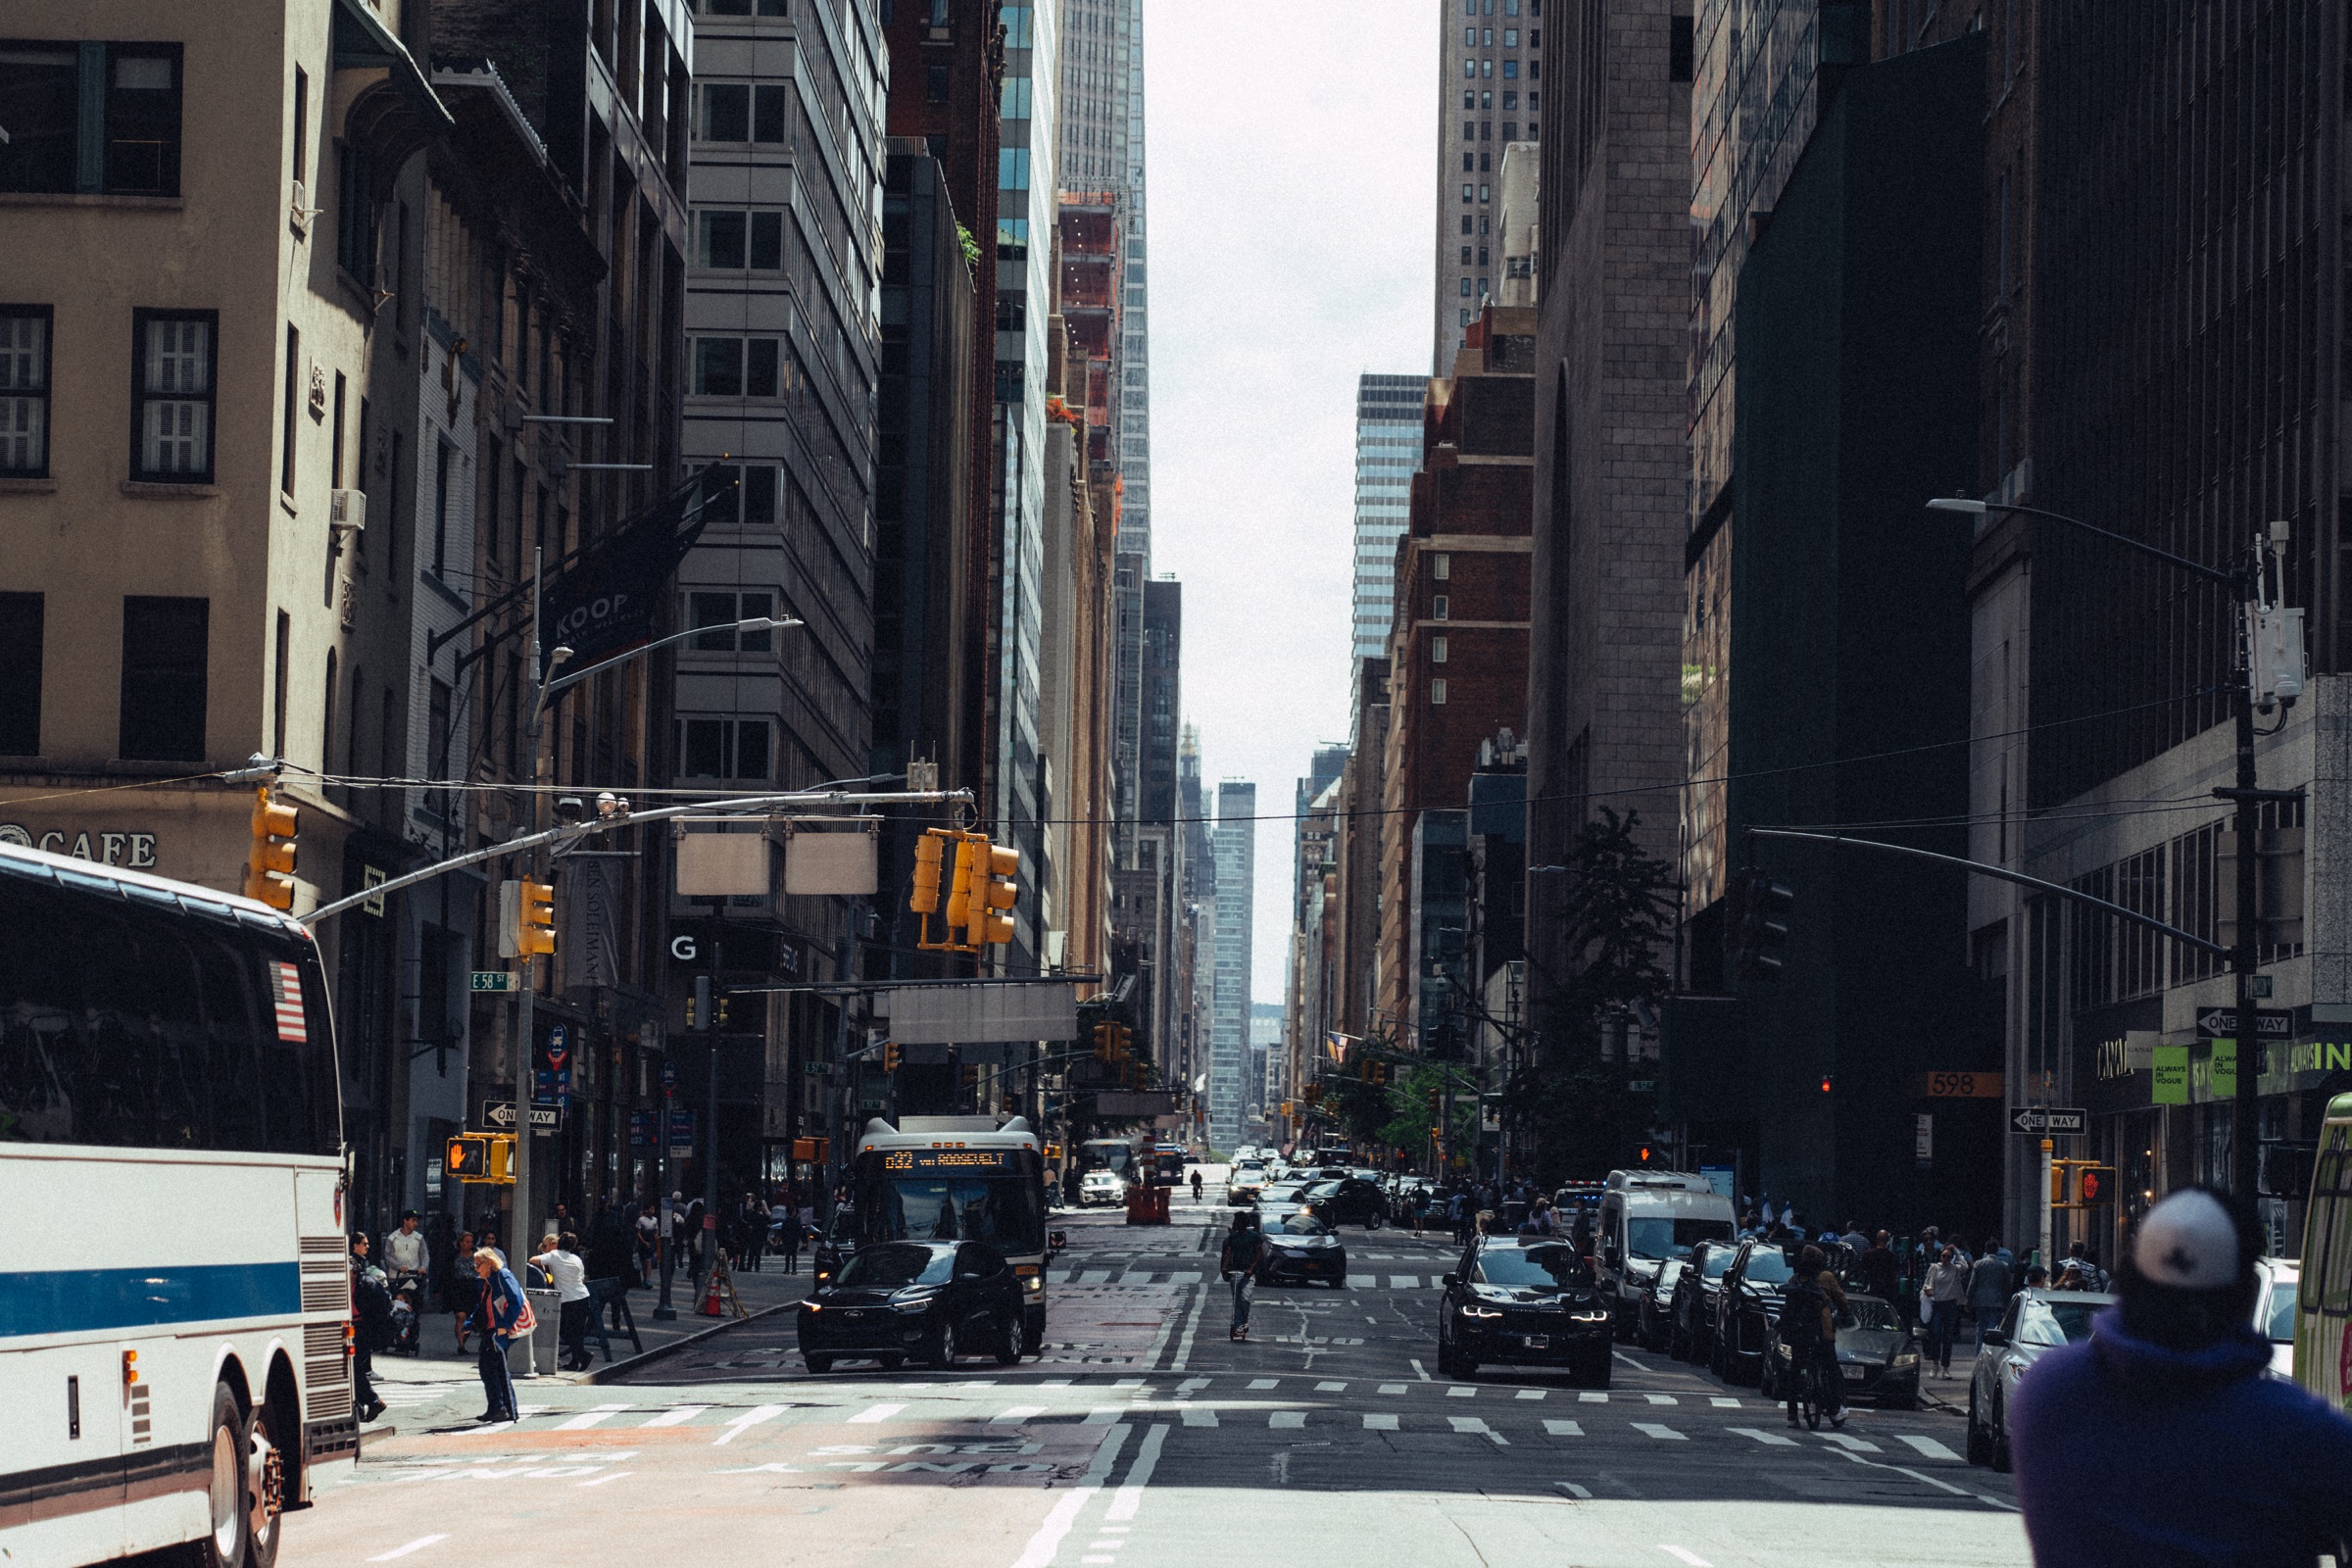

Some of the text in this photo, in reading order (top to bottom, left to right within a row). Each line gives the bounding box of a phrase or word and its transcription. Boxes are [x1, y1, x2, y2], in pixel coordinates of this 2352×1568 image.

[557, 594, 628, 639] KOOP
[587, 860, 600, 888] BEN
[670, 935, 697, 960] G
[472, 973, 478, 989] E
[481, 973, 494, 989] 58
[2208, 1016, 2237, 1029] ONE
[2314, 1042, 2351, 1071] IN
[1933, 1073, 1975, 1095] 598
[498, 1109, 515, 1120] ON
[2021, 1115, 2076, 1127] ONE WAY
[937, 1152, 1004, 1165] ROOSEVELT
